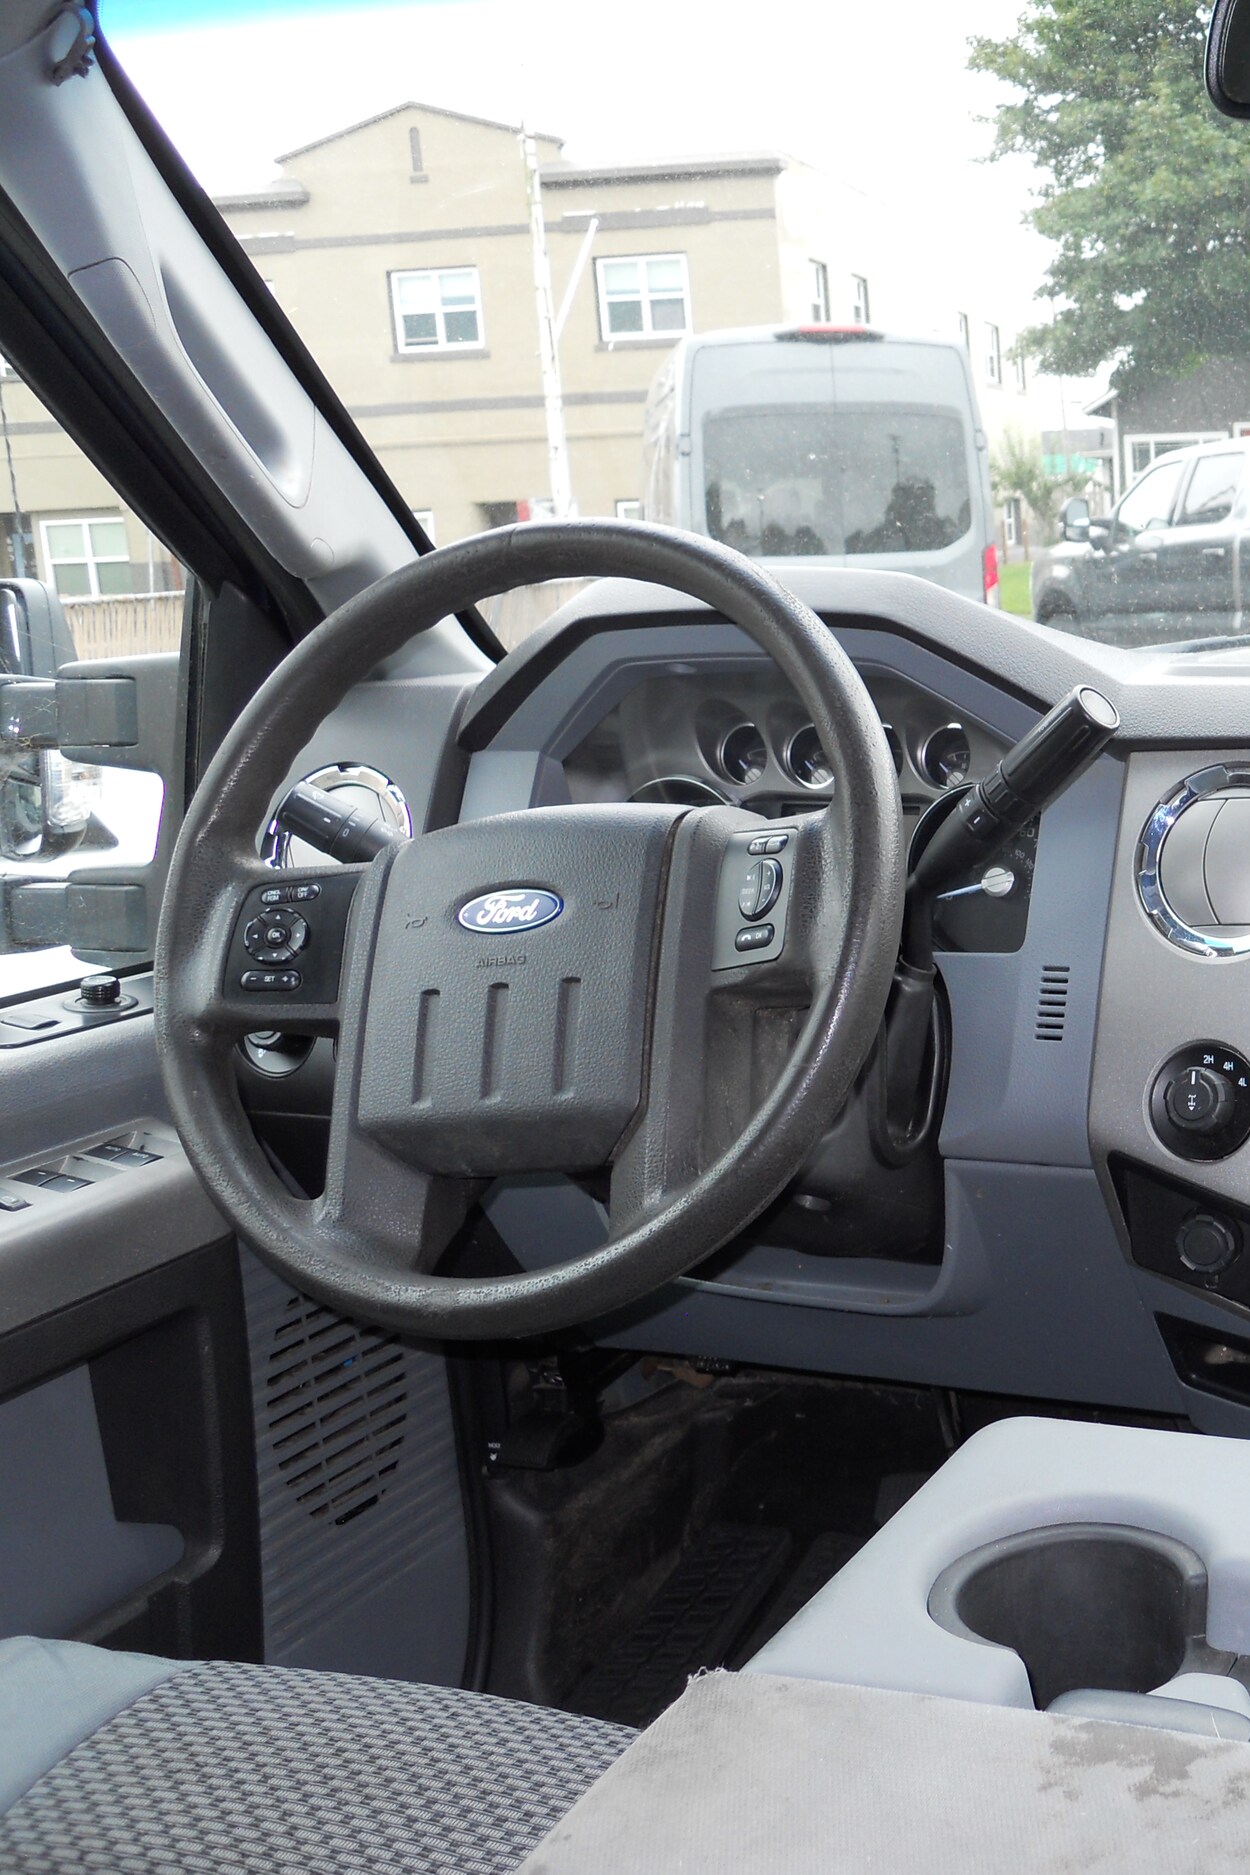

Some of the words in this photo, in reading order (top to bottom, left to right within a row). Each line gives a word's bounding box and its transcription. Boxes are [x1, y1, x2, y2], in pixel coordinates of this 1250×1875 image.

[476, 894, 540, 925] Ford
[477, 955, 527, 968] AIRBAG
[1203, 1054, 1215, 1064] 2H
[1223, 1061, 1234, 1071] 4H
[1238, 1077, 1248, 1087] 4L
